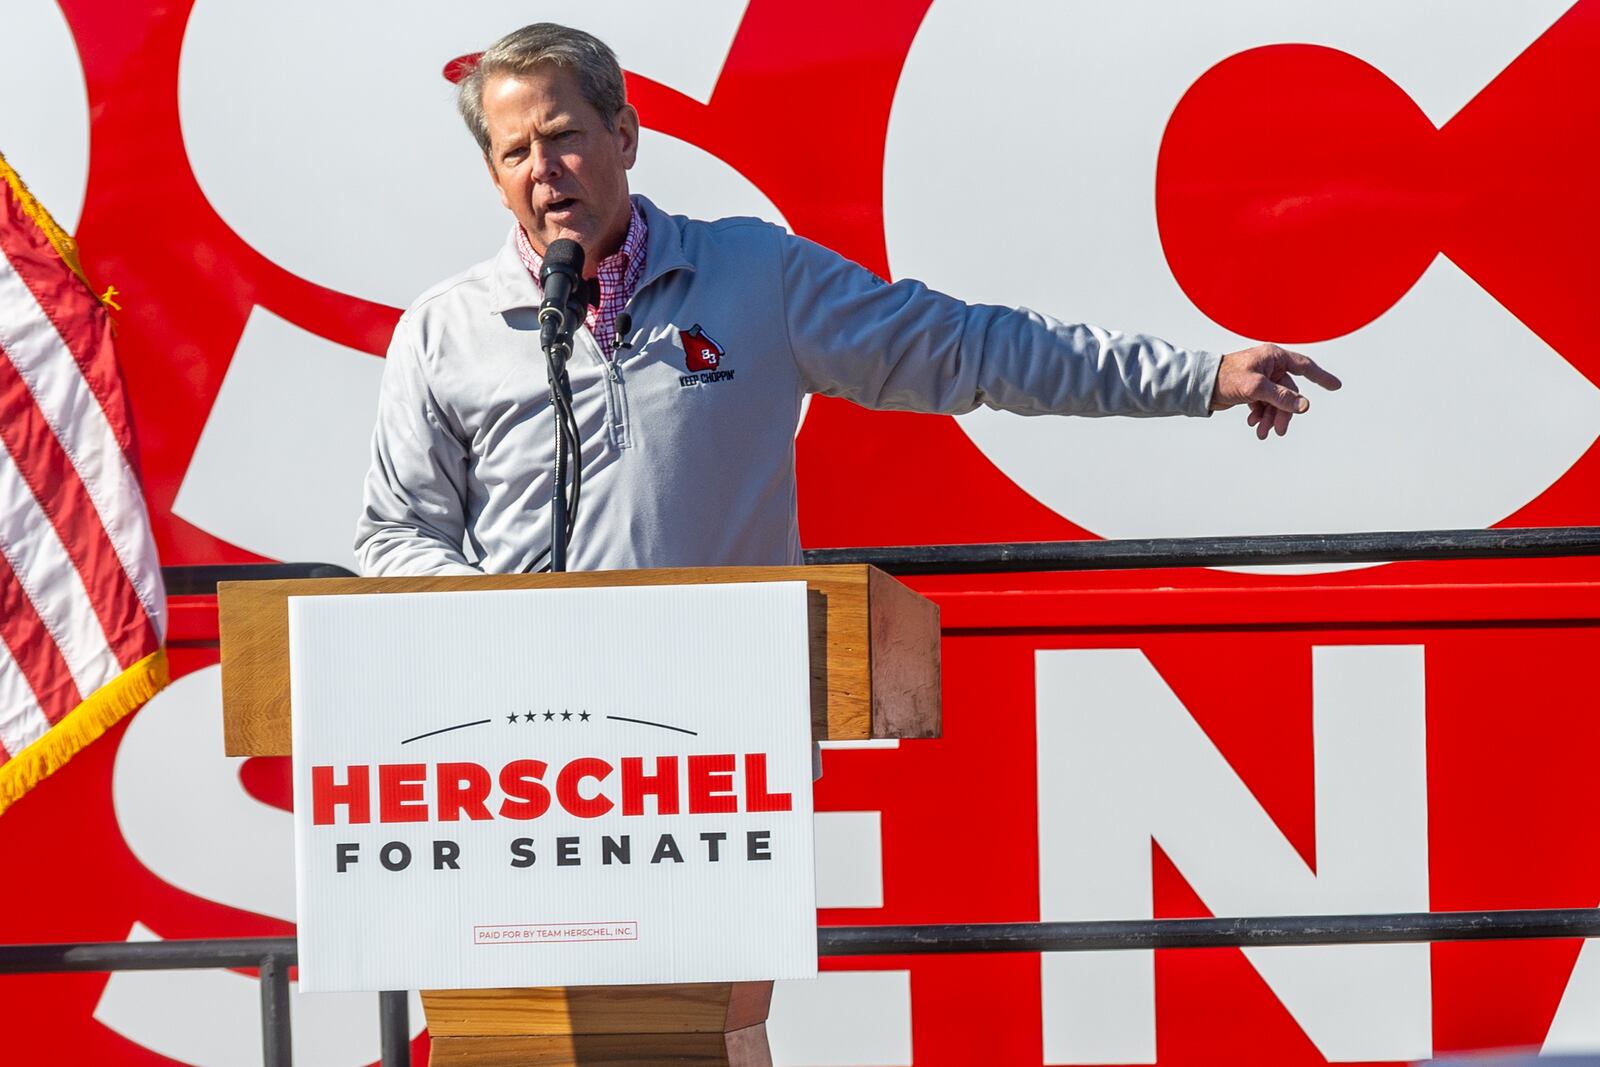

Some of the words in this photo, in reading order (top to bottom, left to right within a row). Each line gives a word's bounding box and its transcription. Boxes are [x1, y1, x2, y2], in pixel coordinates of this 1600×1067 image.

[701, 348, 717, 364] 83
[679, 374, 699, 387] KEEP
[700, 369, 735, 384] CHOPPIN'
[312, 753, 792, 826] HERSCHEL
[336, 840, 461, 873] FOR
[510, 830, 772, 868] SENATE
[479, 931, 500, 940] PAID
[502, 930, 521, 939] FOR
[523, 930, 535, 938] BY
[537, 929, 562, 938] TEAM
[564, 928, 613, 937] HERSCHEL,
[615, 927, 633, 936] INC.
